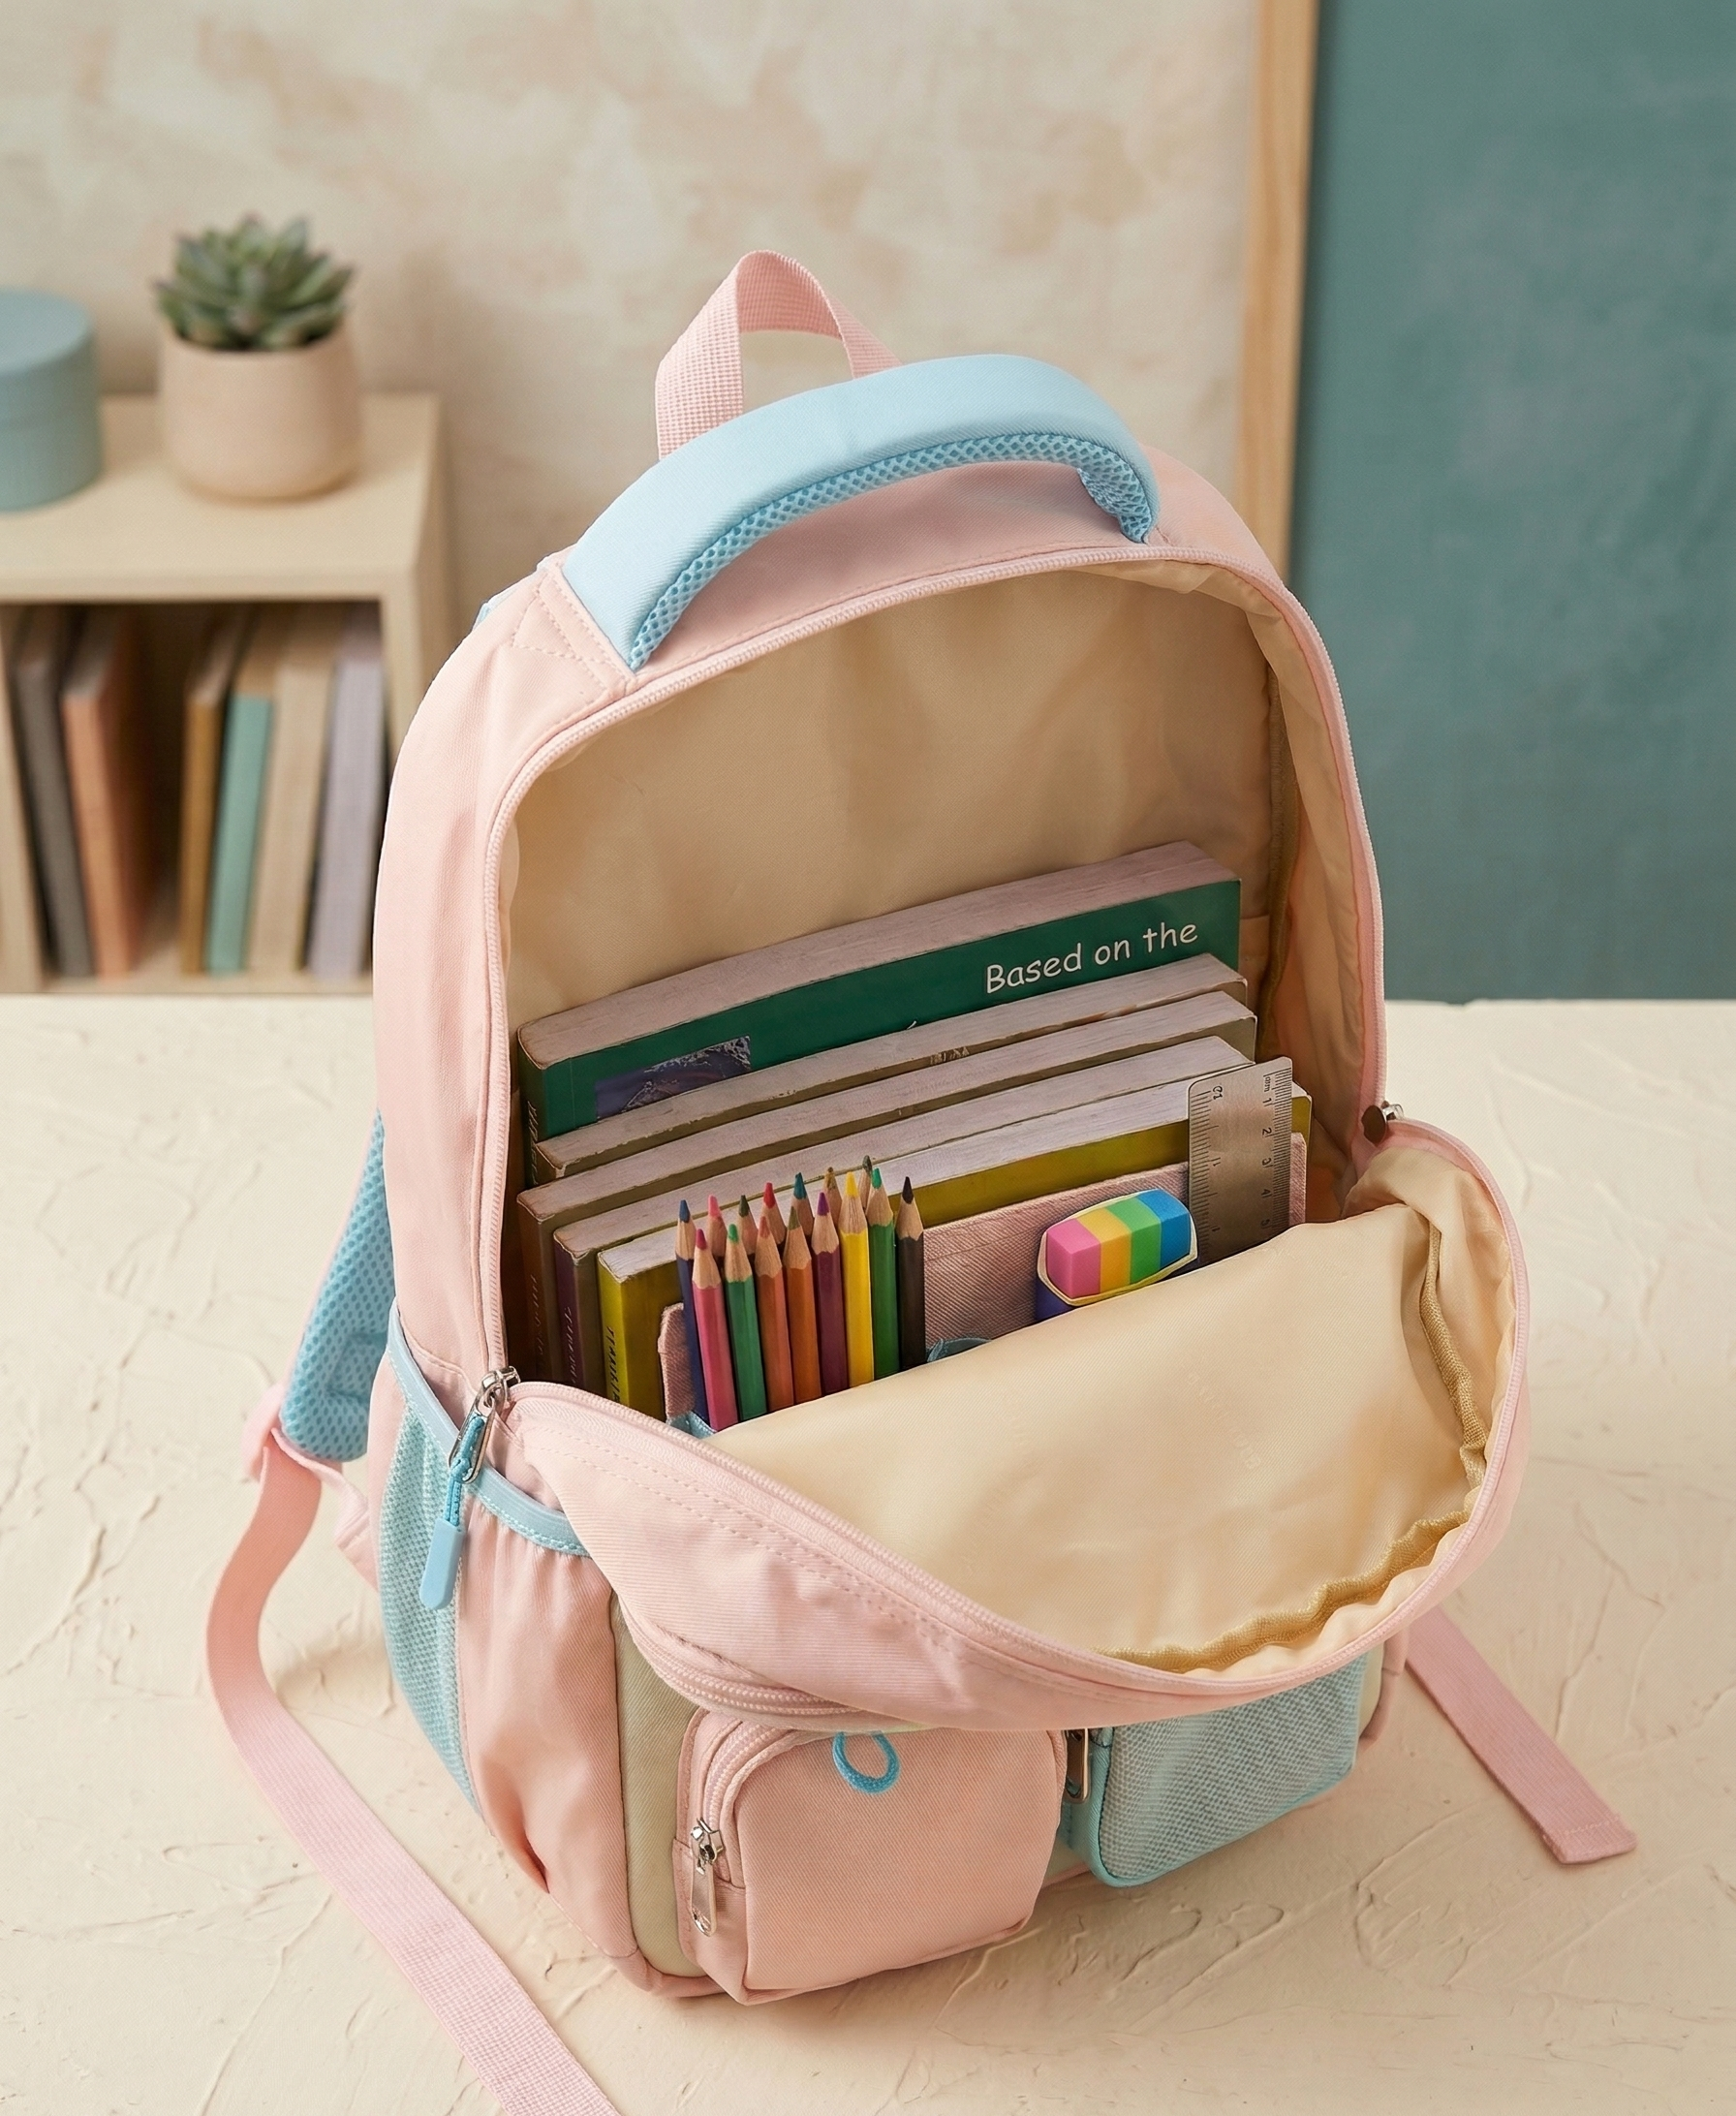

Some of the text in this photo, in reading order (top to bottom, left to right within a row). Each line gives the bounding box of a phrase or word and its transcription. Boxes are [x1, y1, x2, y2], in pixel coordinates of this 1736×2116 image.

[986, 921, 1198, 994] Based on the
[1261, 1127, 1272, 1136] 2
